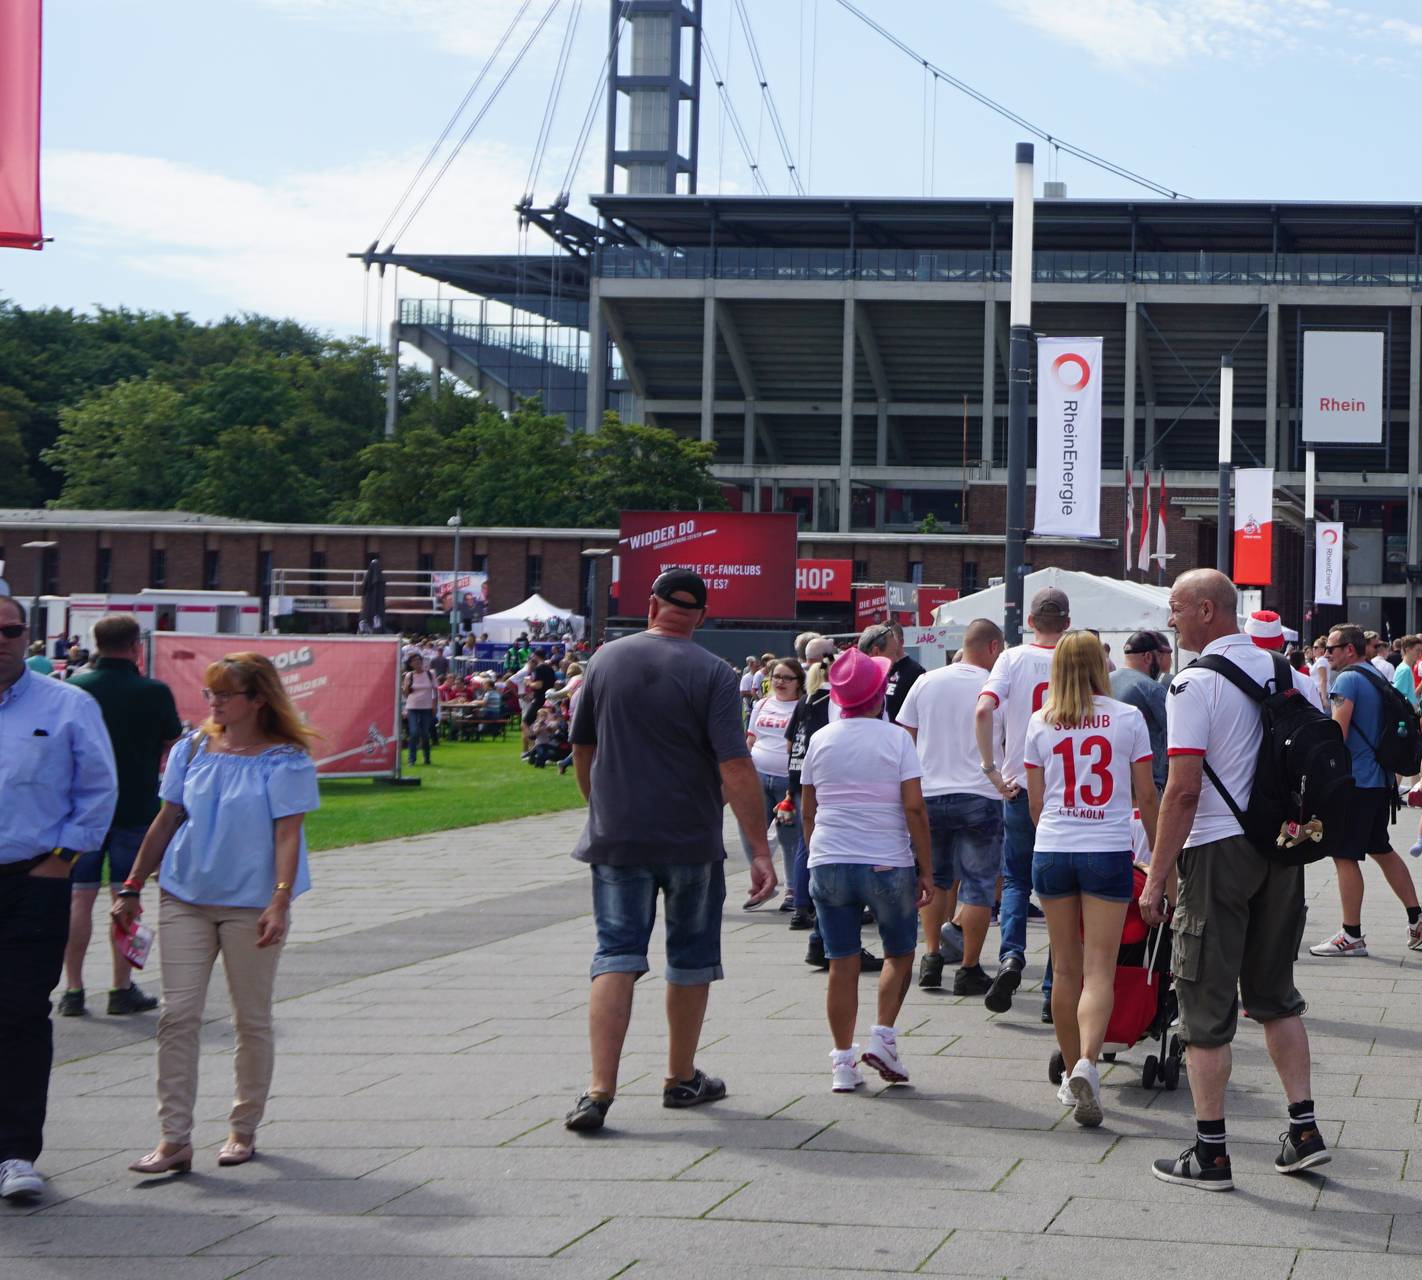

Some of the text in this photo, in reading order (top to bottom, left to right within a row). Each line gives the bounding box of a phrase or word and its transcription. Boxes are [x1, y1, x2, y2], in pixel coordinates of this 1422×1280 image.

[1319, 397, 1365, 412] Rhein
[1059, 400, 1079, 516] RheinEnergie
[629, 525, 676, 550] WIDDER
[679, 519, 695, 537] DO
[703, 564, 761, 576] FC-FANCLUBS
[796, 568, 834, 590] HOP
[713, 579, 729, 590] ES?
[859, 596, 886, 609] DIE NEU
[888, 586, 905, 606] GRILL
[268, 646, 313, 669] OLG
[757, 718, 789, 729] REW
[1053, 735, 1114, 808] 13
